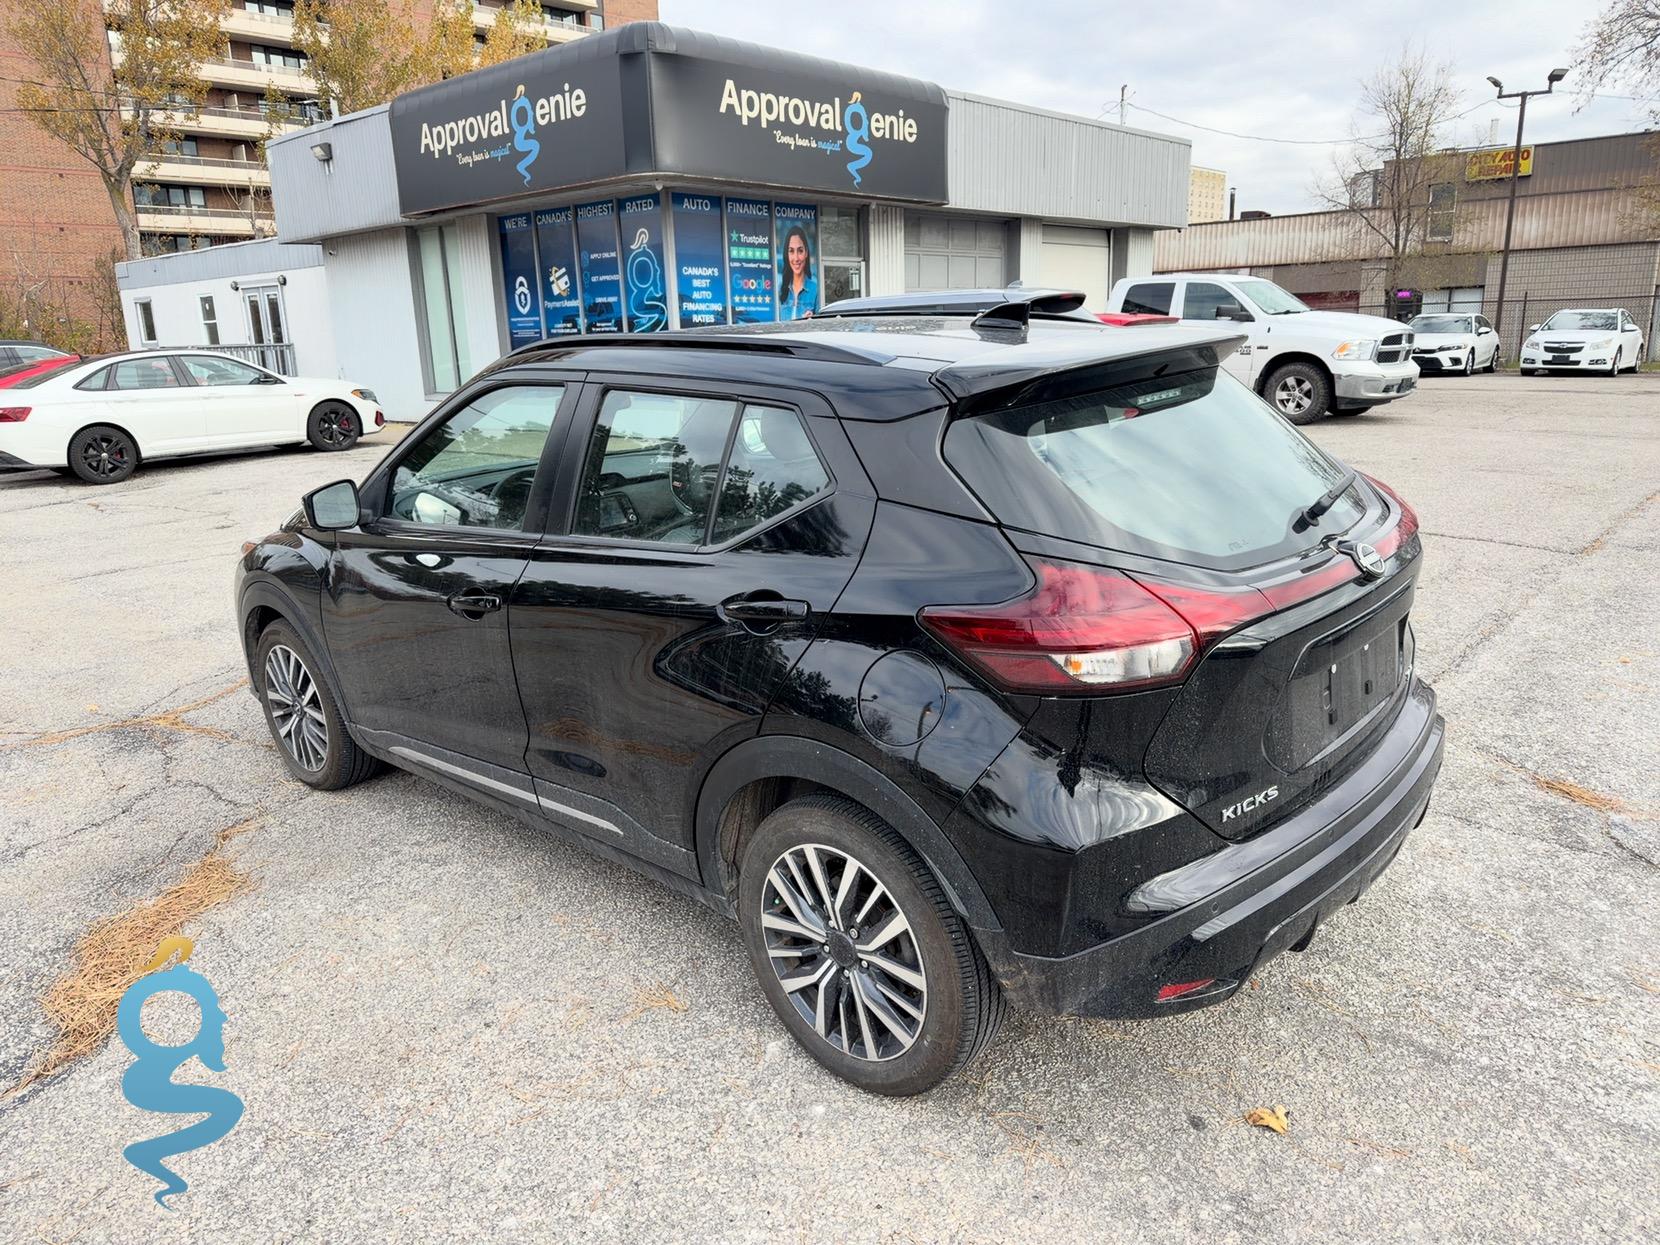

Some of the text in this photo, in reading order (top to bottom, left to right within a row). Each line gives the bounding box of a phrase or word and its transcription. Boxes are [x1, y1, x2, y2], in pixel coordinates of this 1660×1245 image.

[1499, 149, 1531, 163] AUO
[504, 199, 654, 230] WE'RE CANADA'S HIGHEST RATED
[683, 198, 816, 220] AUTO FINANCE COMPANY
[740, 233, 769, 245] Trustpilot
[682, 266, 719, 277] CANADA'S
[692, 279, 711, 288] BEST
[732, 273, 772, 294] Google
[692, 290, 712, 300] AUTO
[682, 302, 723, 312] FINANCING
[692, 314, 715, 323] RATES
[1221, 785, 1279, 823] KICKS
